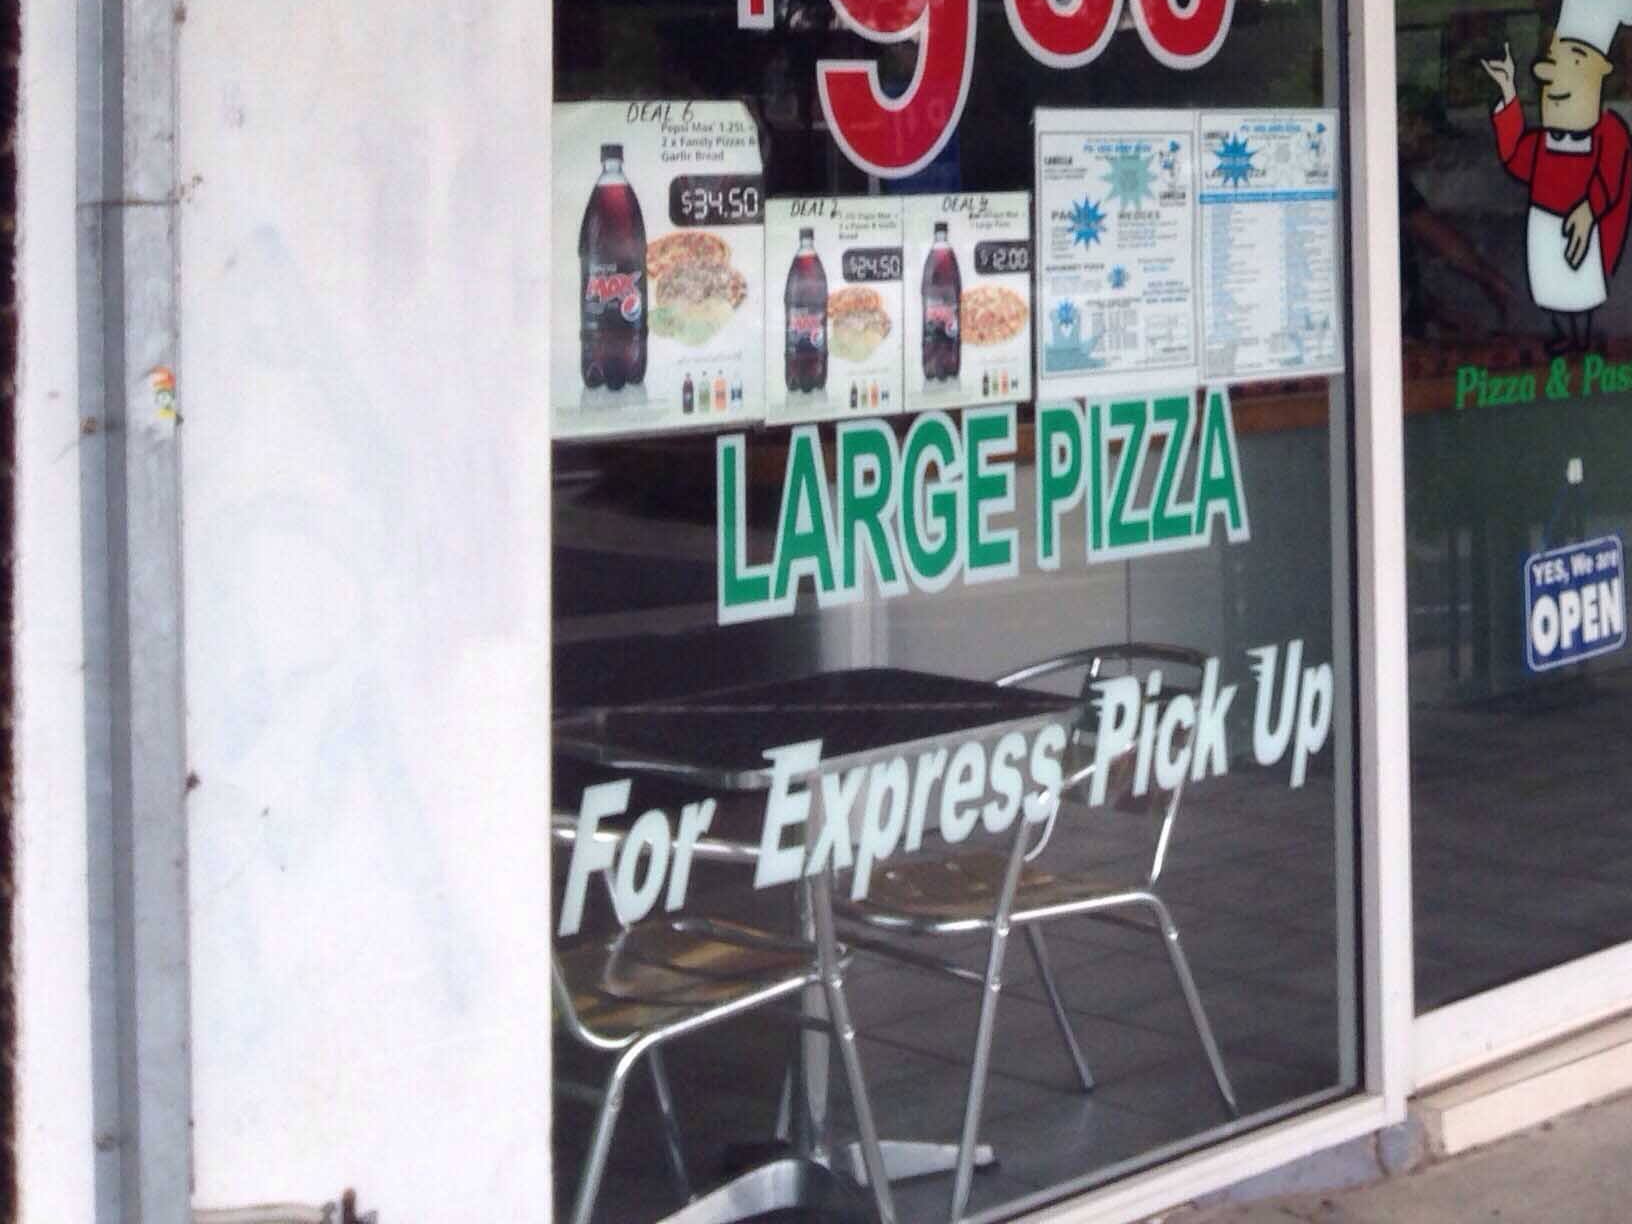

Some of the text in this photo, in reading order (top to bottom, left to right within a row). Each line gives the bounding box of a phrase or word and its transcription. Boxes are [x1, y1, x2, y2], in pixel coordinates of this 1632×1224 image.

[626, 99, 695, 125] DEAL 6
[681, 186, 759, 220] $34.50
[942, 196, 975, 213] DEAL
[1455, 363, 1537, 410] Pizza
[1545, 356, 1571, 400] &
[715, 383, 1251, 626] LARGE PIZZA
[1570, 551, 1594, 577] We
[1531, 576, 1623, 657] OPEN
[558, 638, 1335, 938] For Express Pick Up
